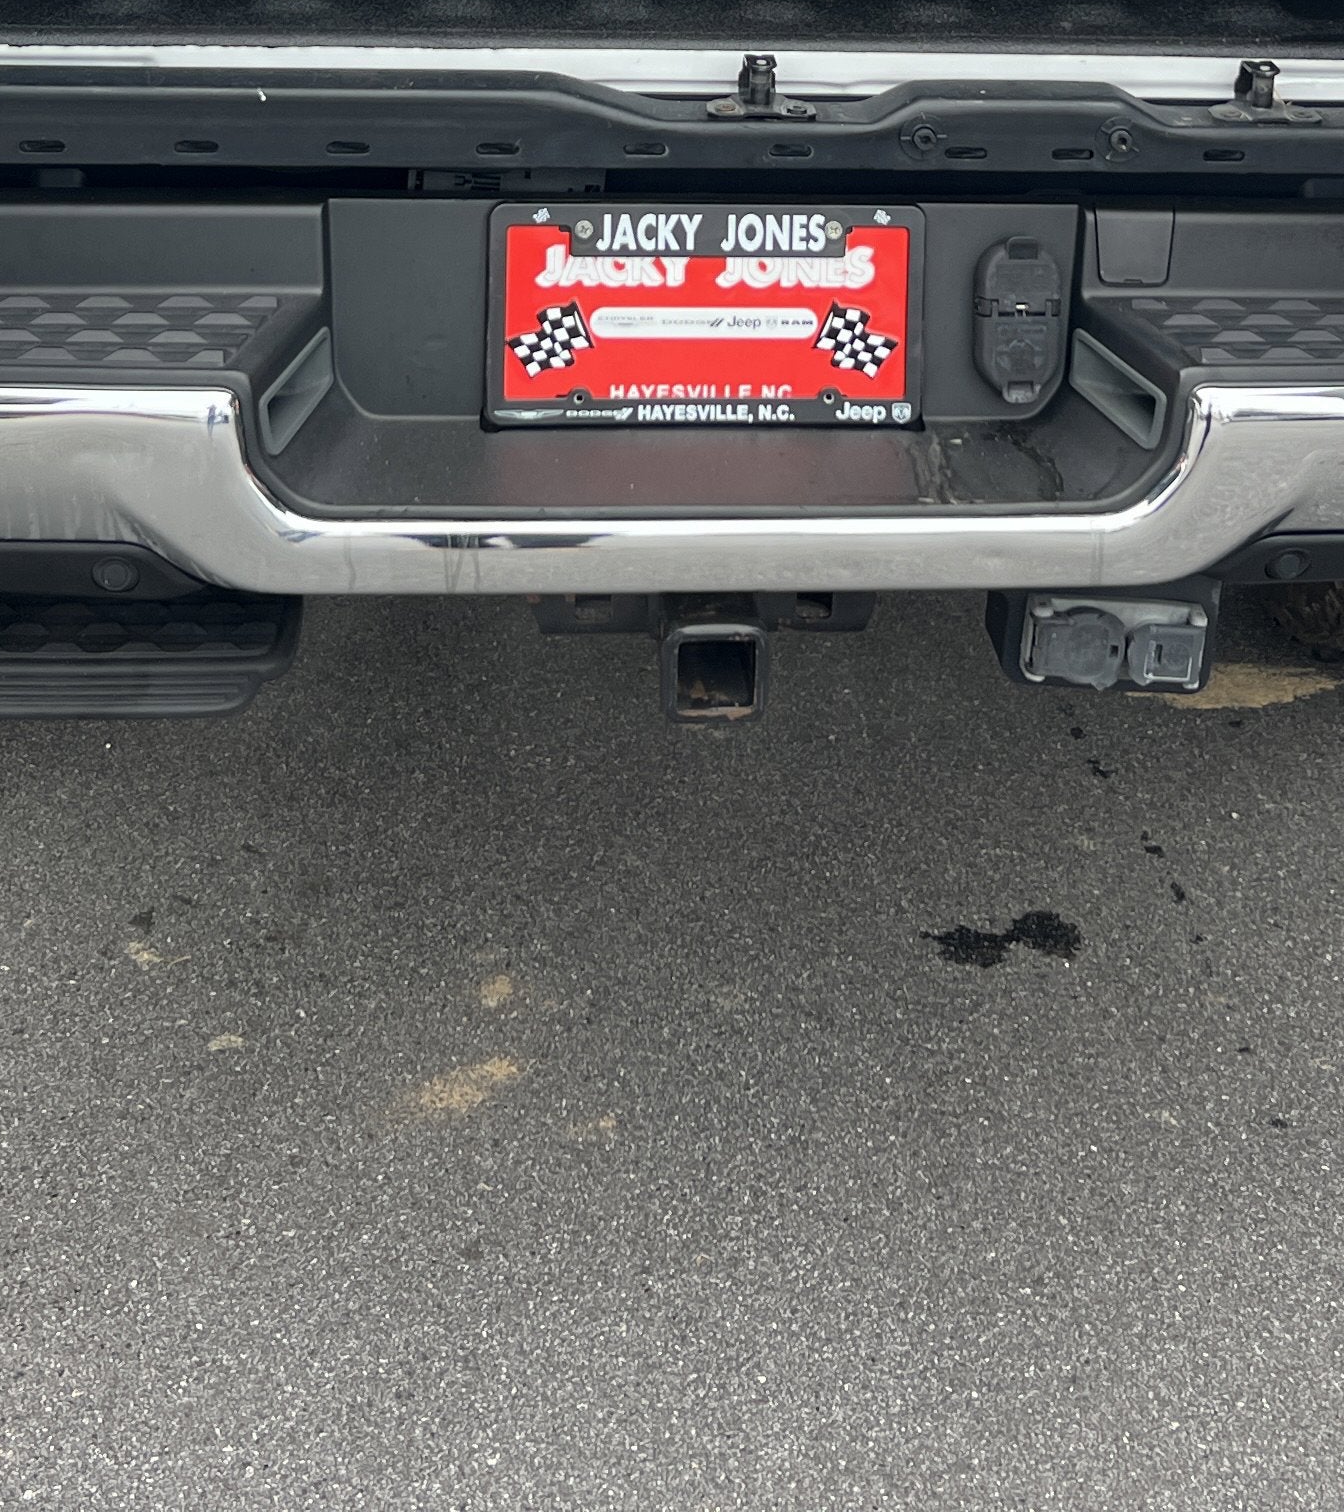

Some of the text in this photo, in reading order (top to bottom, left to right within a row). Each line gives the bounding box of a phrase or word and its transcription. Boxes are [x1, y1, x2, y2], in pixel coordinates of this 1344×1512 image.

[596, 213, 827, 252] JACKY JONES
[535, 243, 875, 288] JACKY JONES
[727, 315, 762, 329] Jeep
[638, 404, 754, 423] HAYESVILLE,
[758, 404, 795, 421] N.C.
[835, 401, 887, 424] Jeep
